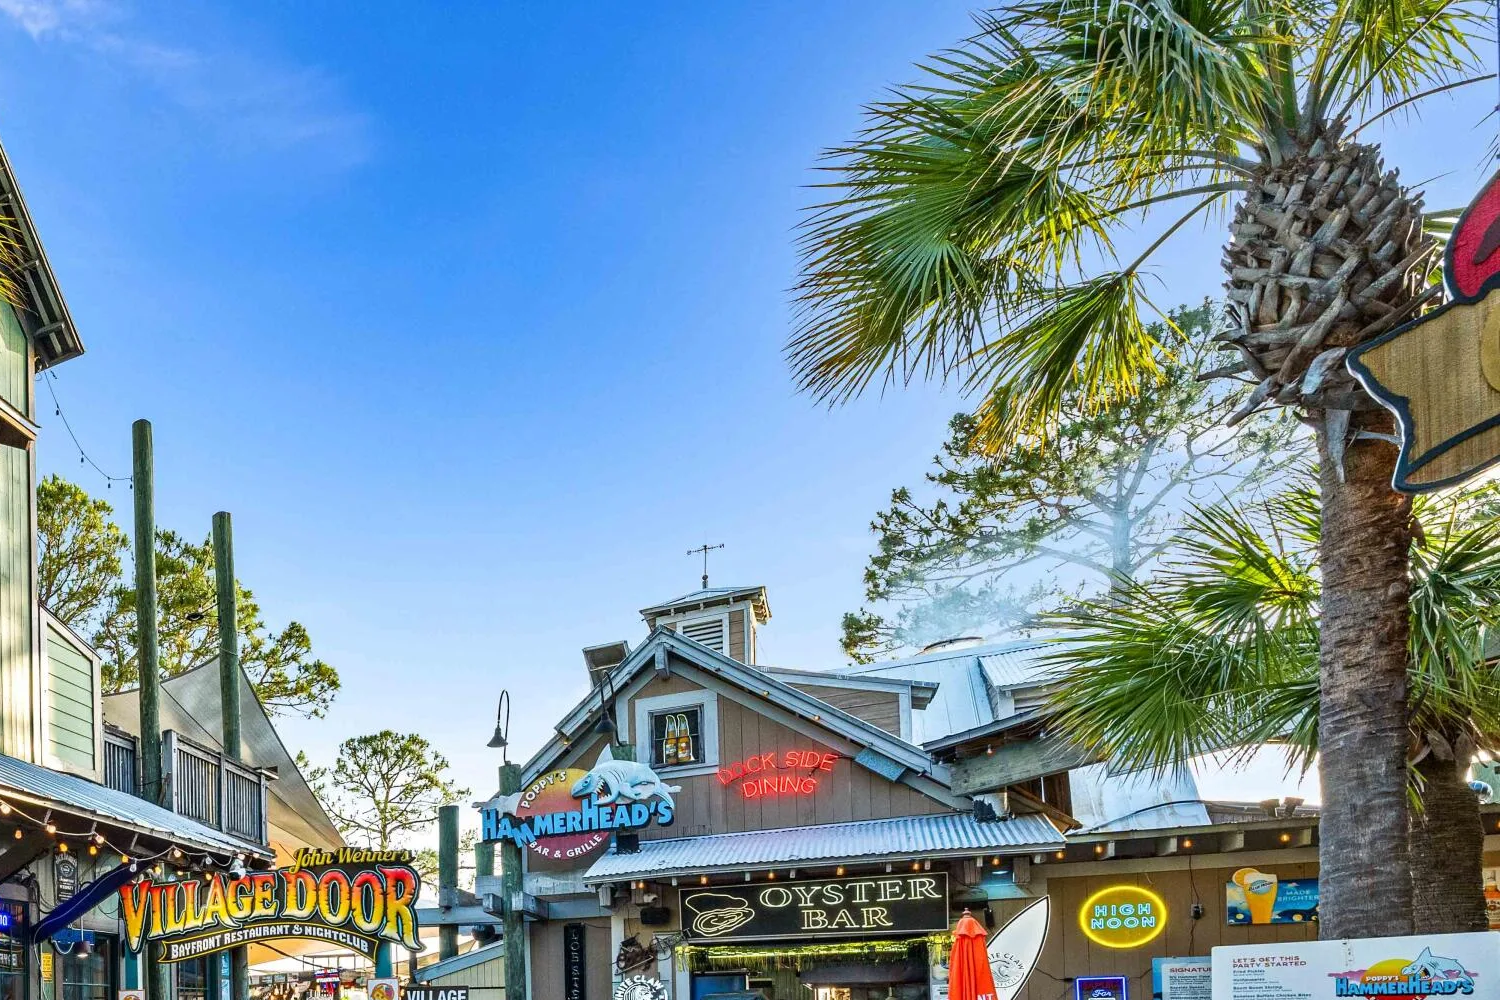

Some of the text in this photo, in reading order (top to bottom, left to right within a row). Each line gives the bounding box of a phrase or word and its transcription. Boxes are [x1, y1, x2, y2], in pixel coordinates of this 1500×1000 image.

[716, 751, 838, 786] DOCK SIDE
[521, 771, 567, 809] POPPY'S
[742, 776, 817, 798] DINING
[481, 793, 674, 848] HAMMERHEAD'S
[529, 834, 603, 859] BAR & GRILLE
[290, 848, 414, 874] John Wehner's
[759, 878, 943, 908] OYSTER
[119, 867, 426, 953] VILLAGE DOOR
[801, 907, 893, 930] BAR
[1094, 903, 1152, 917] HIGH
[1091, 916, 1156, 930] NOON
[171, 925, 369, 960] BAYFRONT RESTAURANT & NIGHTCLUB
[633, 974, 664, 990] CLAW
[1335, 974, 1474, 996] HAMMERHEAD'S
